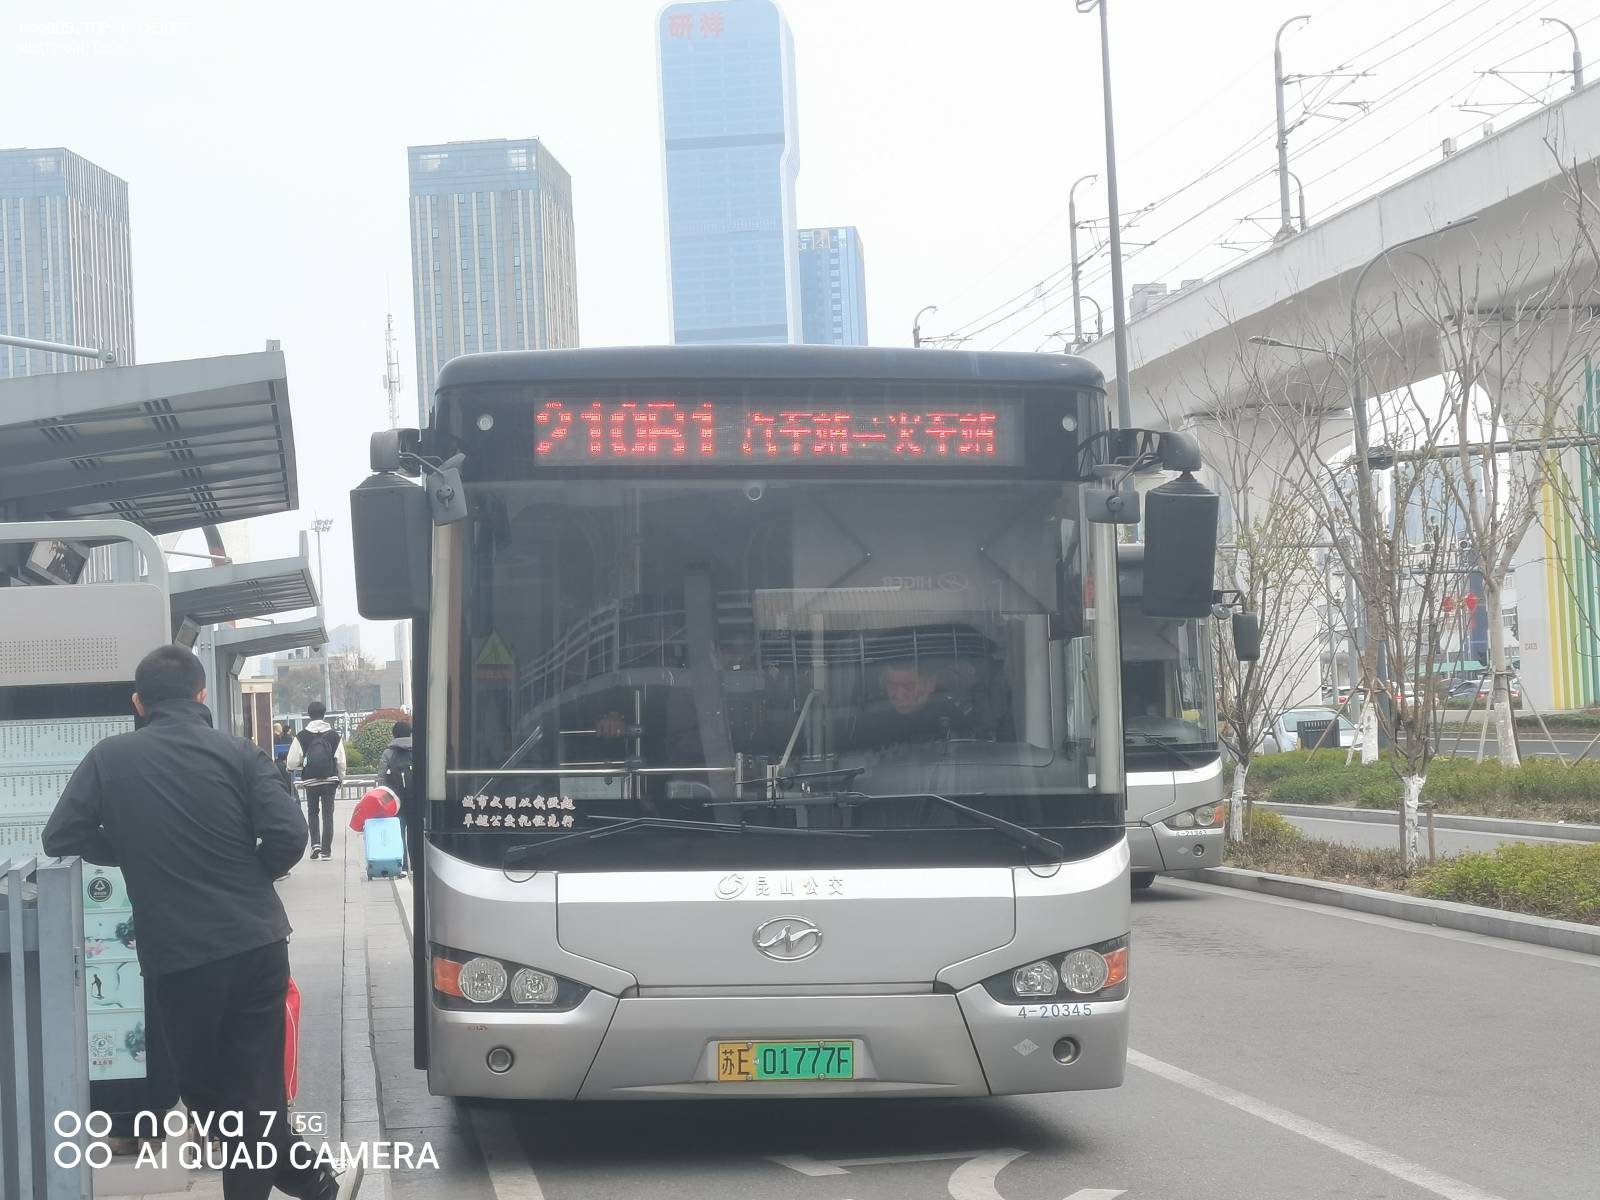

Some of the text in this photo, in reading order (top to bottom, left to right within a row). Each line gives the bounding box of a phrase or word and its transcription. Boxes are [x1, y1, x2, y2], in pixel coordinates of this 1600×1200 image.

[755, 876, 844, 896] 昆山公交
[1017, 1003, 1093, 1019] 4-20345
